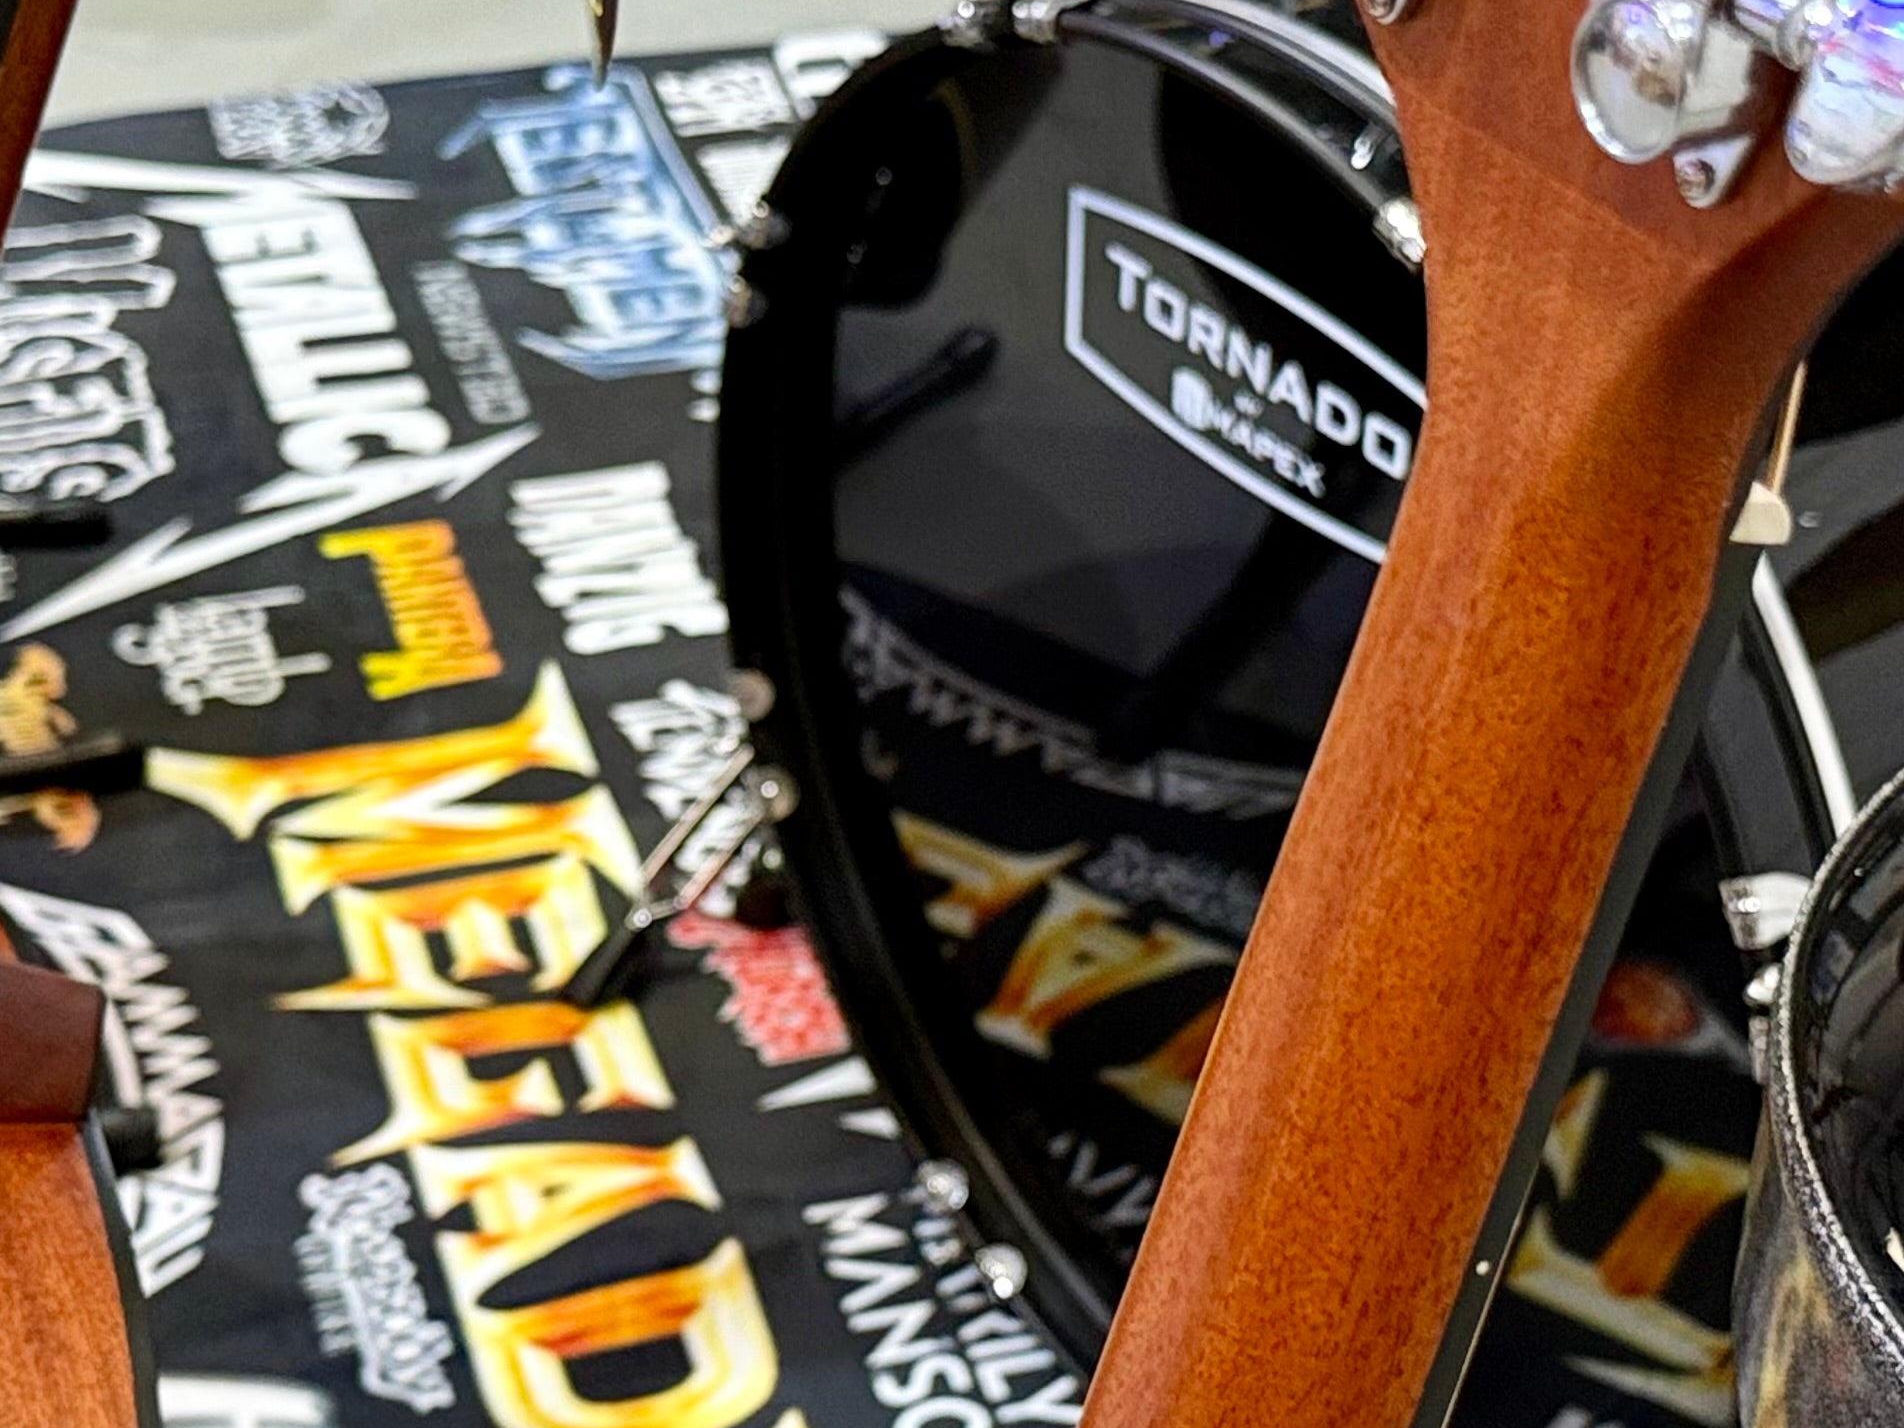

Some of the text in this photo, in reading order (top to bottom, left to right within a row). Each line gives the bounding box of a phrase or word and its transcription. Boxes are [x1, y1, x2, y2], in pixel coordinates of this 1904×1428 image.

[439, 63, 740, 424] TESTAMEN
[1104, 241, 1413, 482] TORNADO
[317, 519, 504, 702] PANTERA
[508, 460, 730, 655] DANZIG
